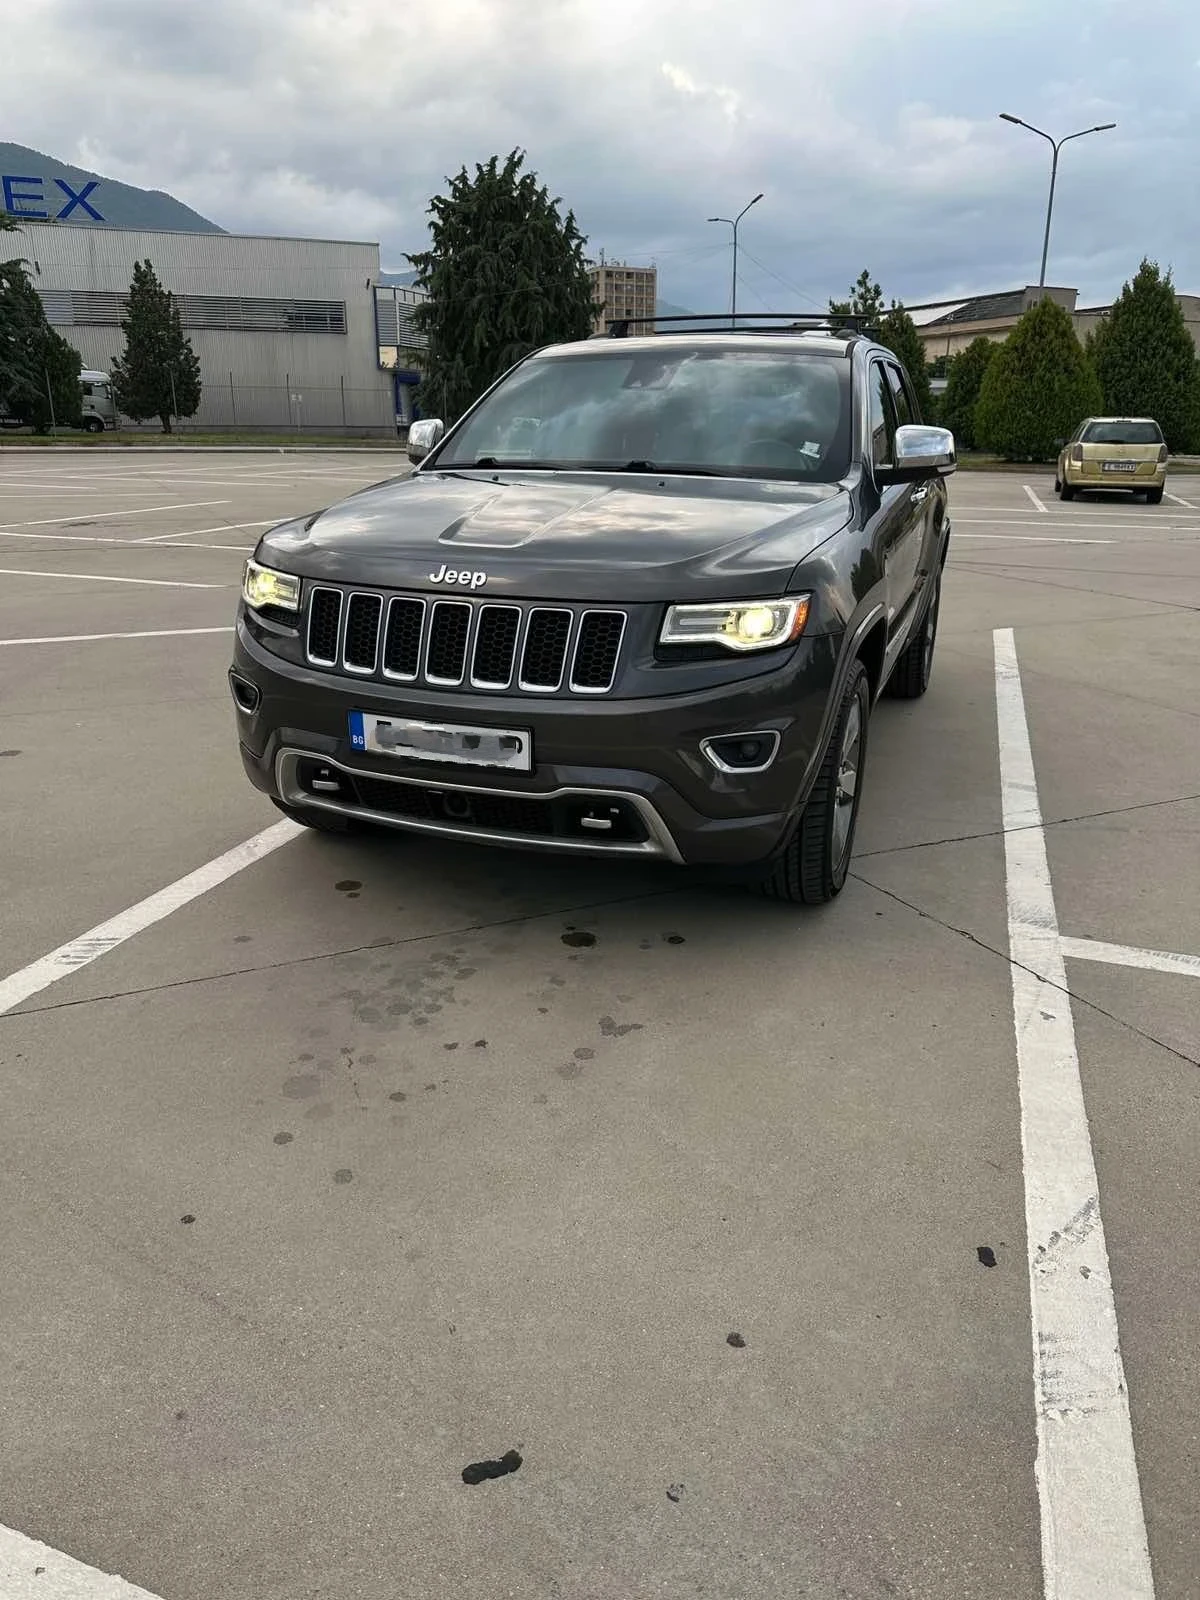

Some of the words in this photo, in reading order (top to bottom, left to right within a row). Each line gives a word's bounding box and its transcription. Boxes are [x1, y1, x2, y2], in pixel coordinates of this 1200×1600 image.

[2, 175, 106, 221] EX
[429, 564, 487, 590] Jeep
[352, 734, 364, 745] BG
